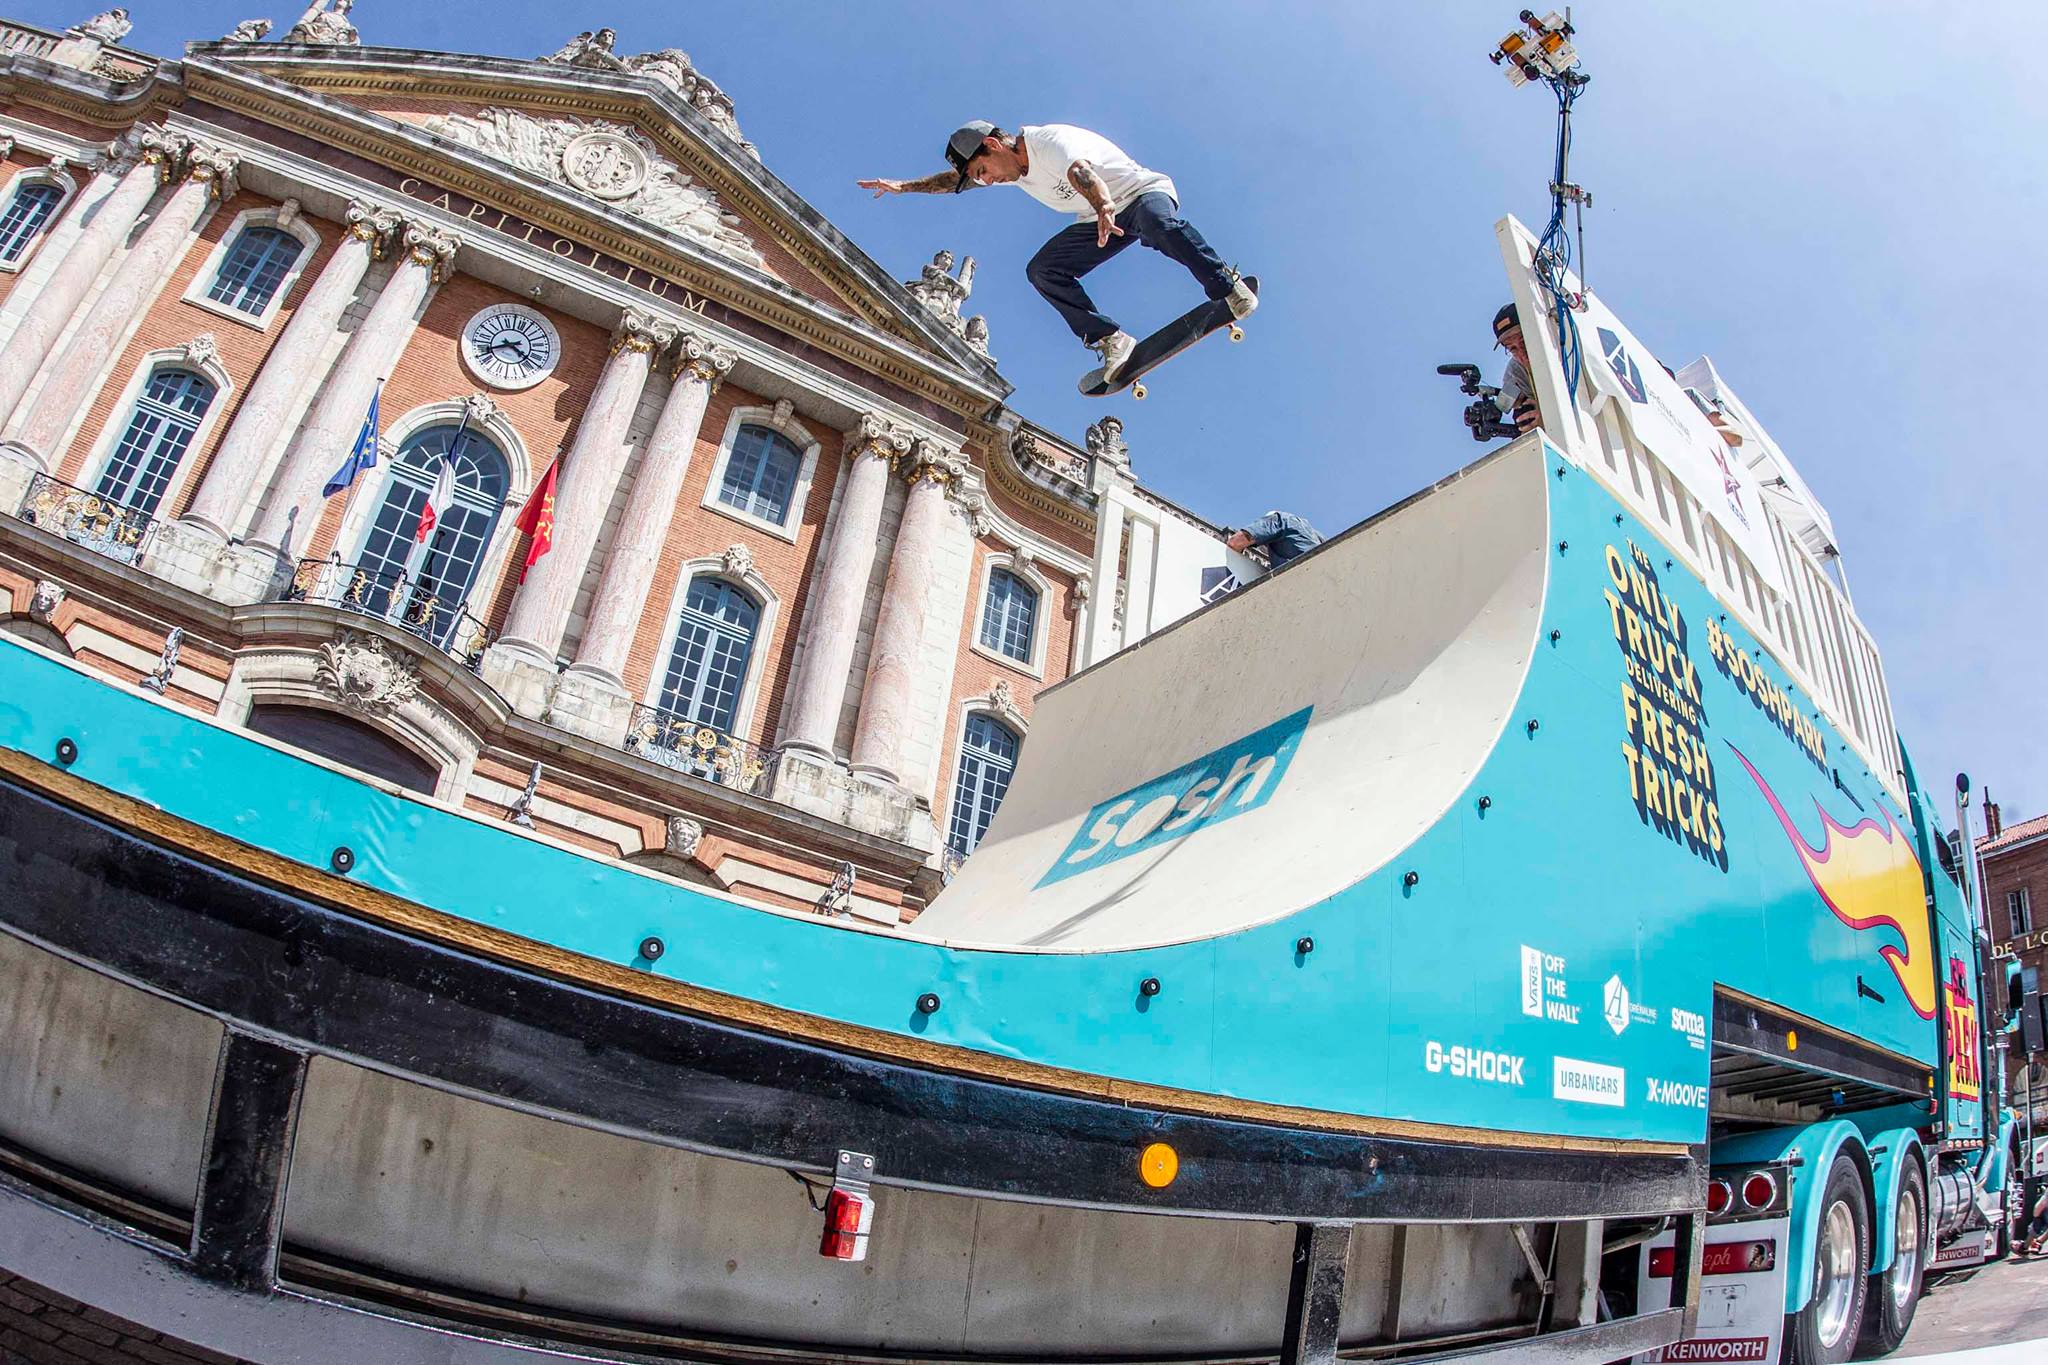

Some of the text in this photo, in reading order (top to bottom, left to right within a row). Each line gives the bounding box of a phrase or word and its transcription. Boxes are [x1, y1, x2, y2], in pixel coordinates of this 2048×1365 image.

[400, 179, 708, 315] CAPITOLIUM
[1626, 537, 1650, 571] THE
[1605, 544, 1680, 641] ONLY
[1603, 586, 1701, 706] TRUCK
[1624, 653, 1696, 726] DELIVERING
[1706, 616, 1828, 767] #SOSHPARK
[1621, 681, 1713, 790] FRESH
[1066, 753, 1277, 864] sosh
[1621, 740, 1722, 852] TRICKS
[1545, 976, 1568, 998] THE
[1425, 1040, 1524, 1086] G-SHOCK
[1560, 1070, 1618, 1095] URBANEARS
[1646, 1077, 1707, 1109] X-MOOVE
[1937, 1247, 1979, 1260] ENWORTH
[1667, 1341, 1764, 1359] KENWORTH
